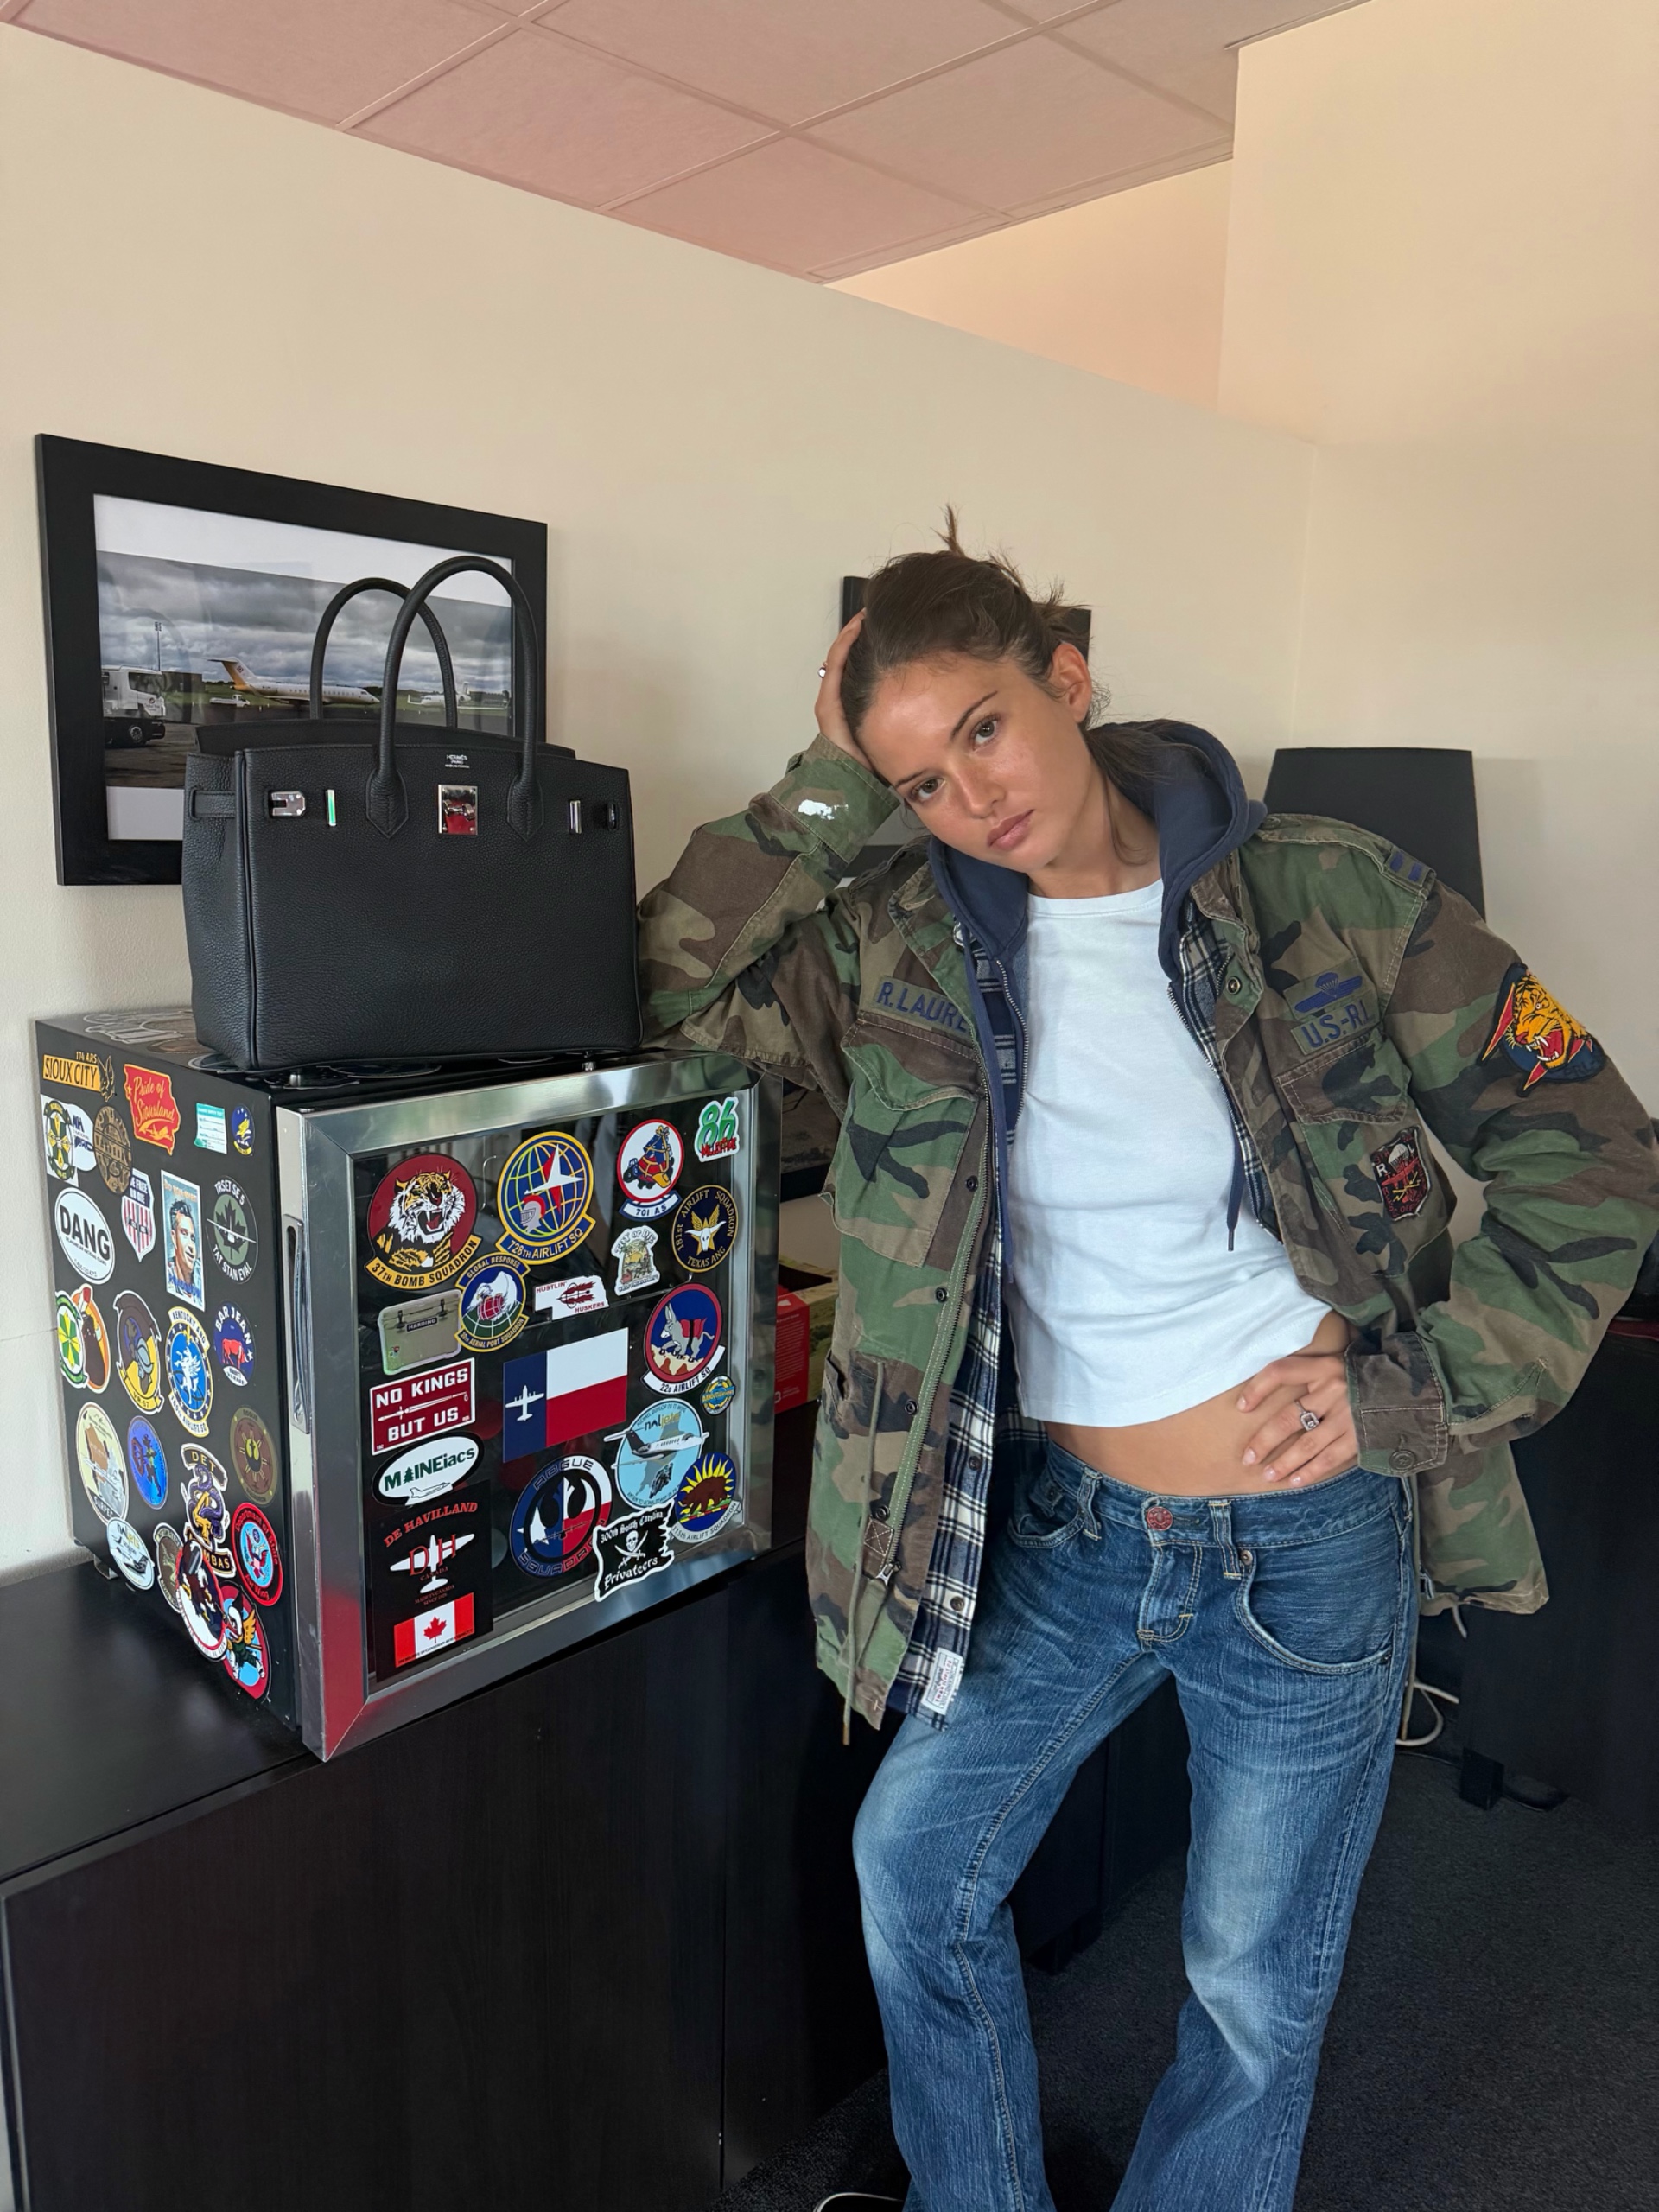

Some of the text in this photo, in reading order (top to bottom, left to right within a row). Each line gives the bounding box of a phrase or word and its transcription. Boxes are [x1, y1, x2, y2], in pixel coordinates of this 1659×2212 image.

[44, 1057, 99, 1089] SIOUX CITY
[134, 1076, 166, 1104] Pride of
[136, 1098, 175, 1126] Siouxland
[696, 1099, 737, 1150] 86
[635, 1203, 667, 1217] 701 AS
[681, 1189, 710, 1219] AIRLIFT
[715, 1190, 735, 1238] SQUADRON
[60, 1204, 111, 1262] DANG
[531, 1239, 569, 1260] AIRLIFT
[569, 1228, 583, 1243] SQ
[222, 1262, 238, 1281] STAN
[238, 1262, 253, 1281] EVAL
[372, 1240, 478, 1287] 37TH BOMB SQUADRON
[467, 1255, 521, 1279] GLOBAL RESPONSE
[686, 1245, 727, 1268] TEXAS ANG
[575, 1301, 605, 1313] HUSKERS
[408, 1318, 437, 1332] HARDING
[486, 1338, 500, 1348] PORT
[500, 1318, 525, 1343] SQUADRON
[376, 1368, 468, 1408] NO KINGS
[673, 1376, 701, 1393] AIRLIFT
[701, 1366, 711, 1379] SQ
[388, 1407, 459, 1443] BUT US
[191, 1451, 216, 1472] DET
[533, 1458, 594, 1491] ROGUE
[383, 1502, 478, 1548] DE HAVILLAND
[639, 1510, 664, 1527] Carolina
[686, 1530, 709, 1541] AIRLIFT
[709, 1502, 737, 1535] SQUADRON
[409, 1534, 457, 1577] DH
[603, 1556, 658, 1591] Privateers
